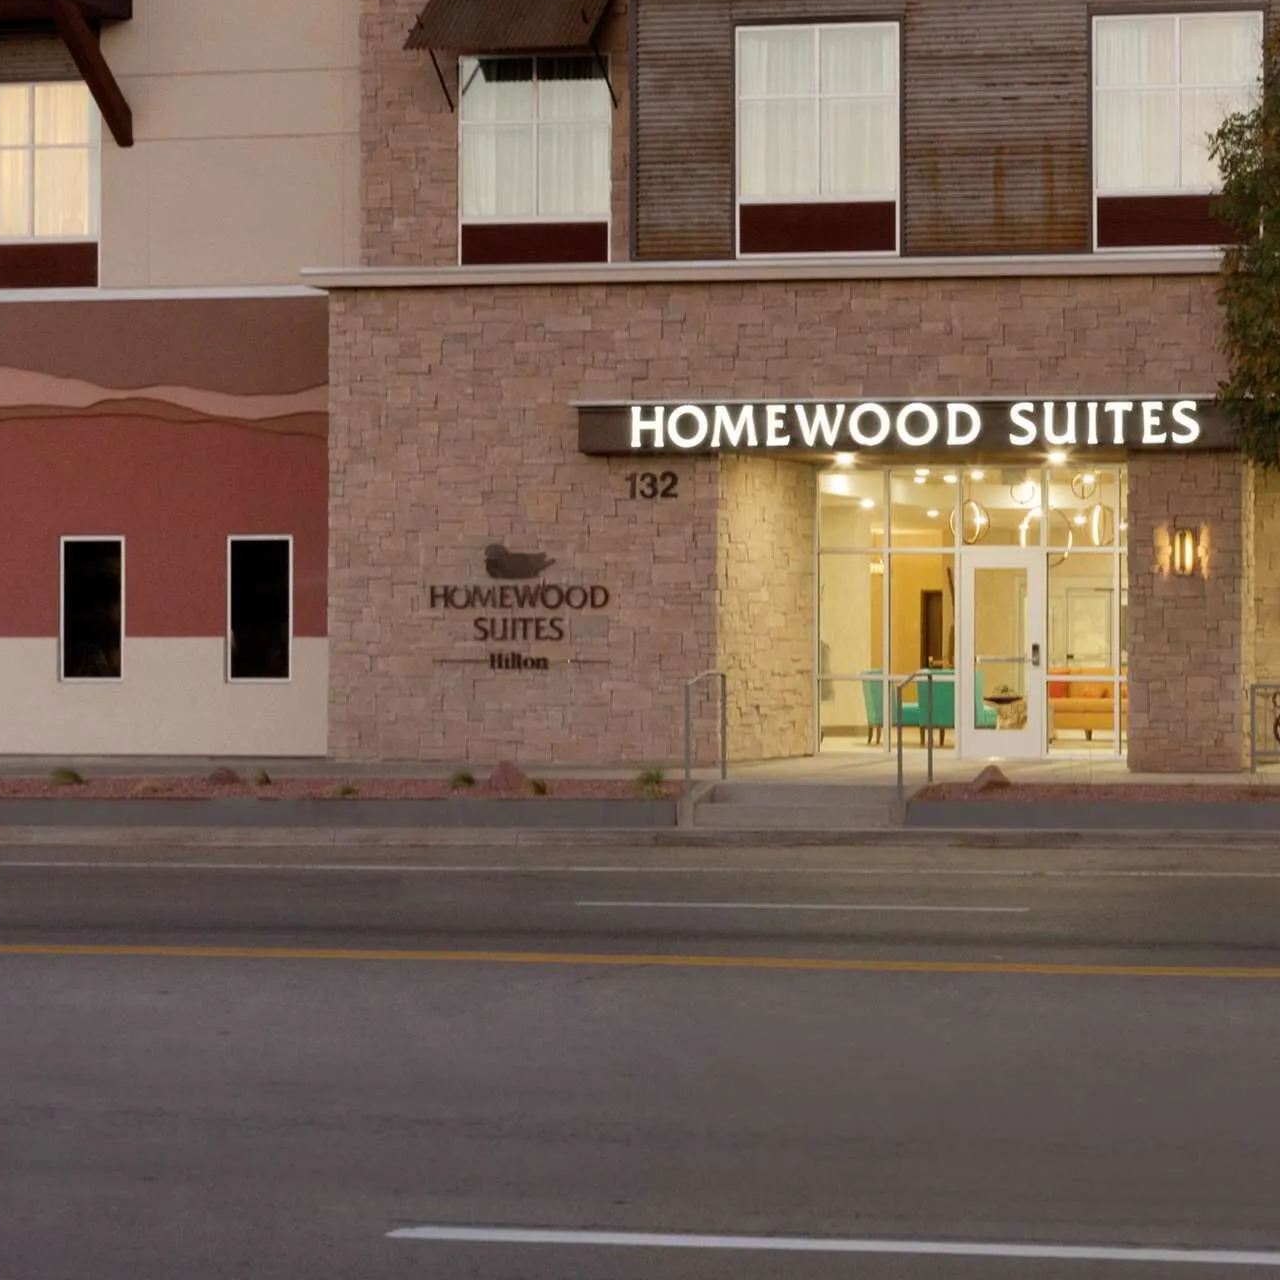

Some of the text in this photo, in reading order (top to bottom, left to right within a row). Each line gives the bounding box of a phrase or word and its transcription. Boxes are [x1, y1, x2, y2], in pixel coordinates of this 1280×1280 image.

[630, 400, 1200, 448] HOMEWOOD SUITES
[624, 471, 679, 499] 132
[429, 584, 609, 609] HOMEWOOD
[473, 617, 564, 641] SUITES
[489, 651, 550, 670] Hilton
